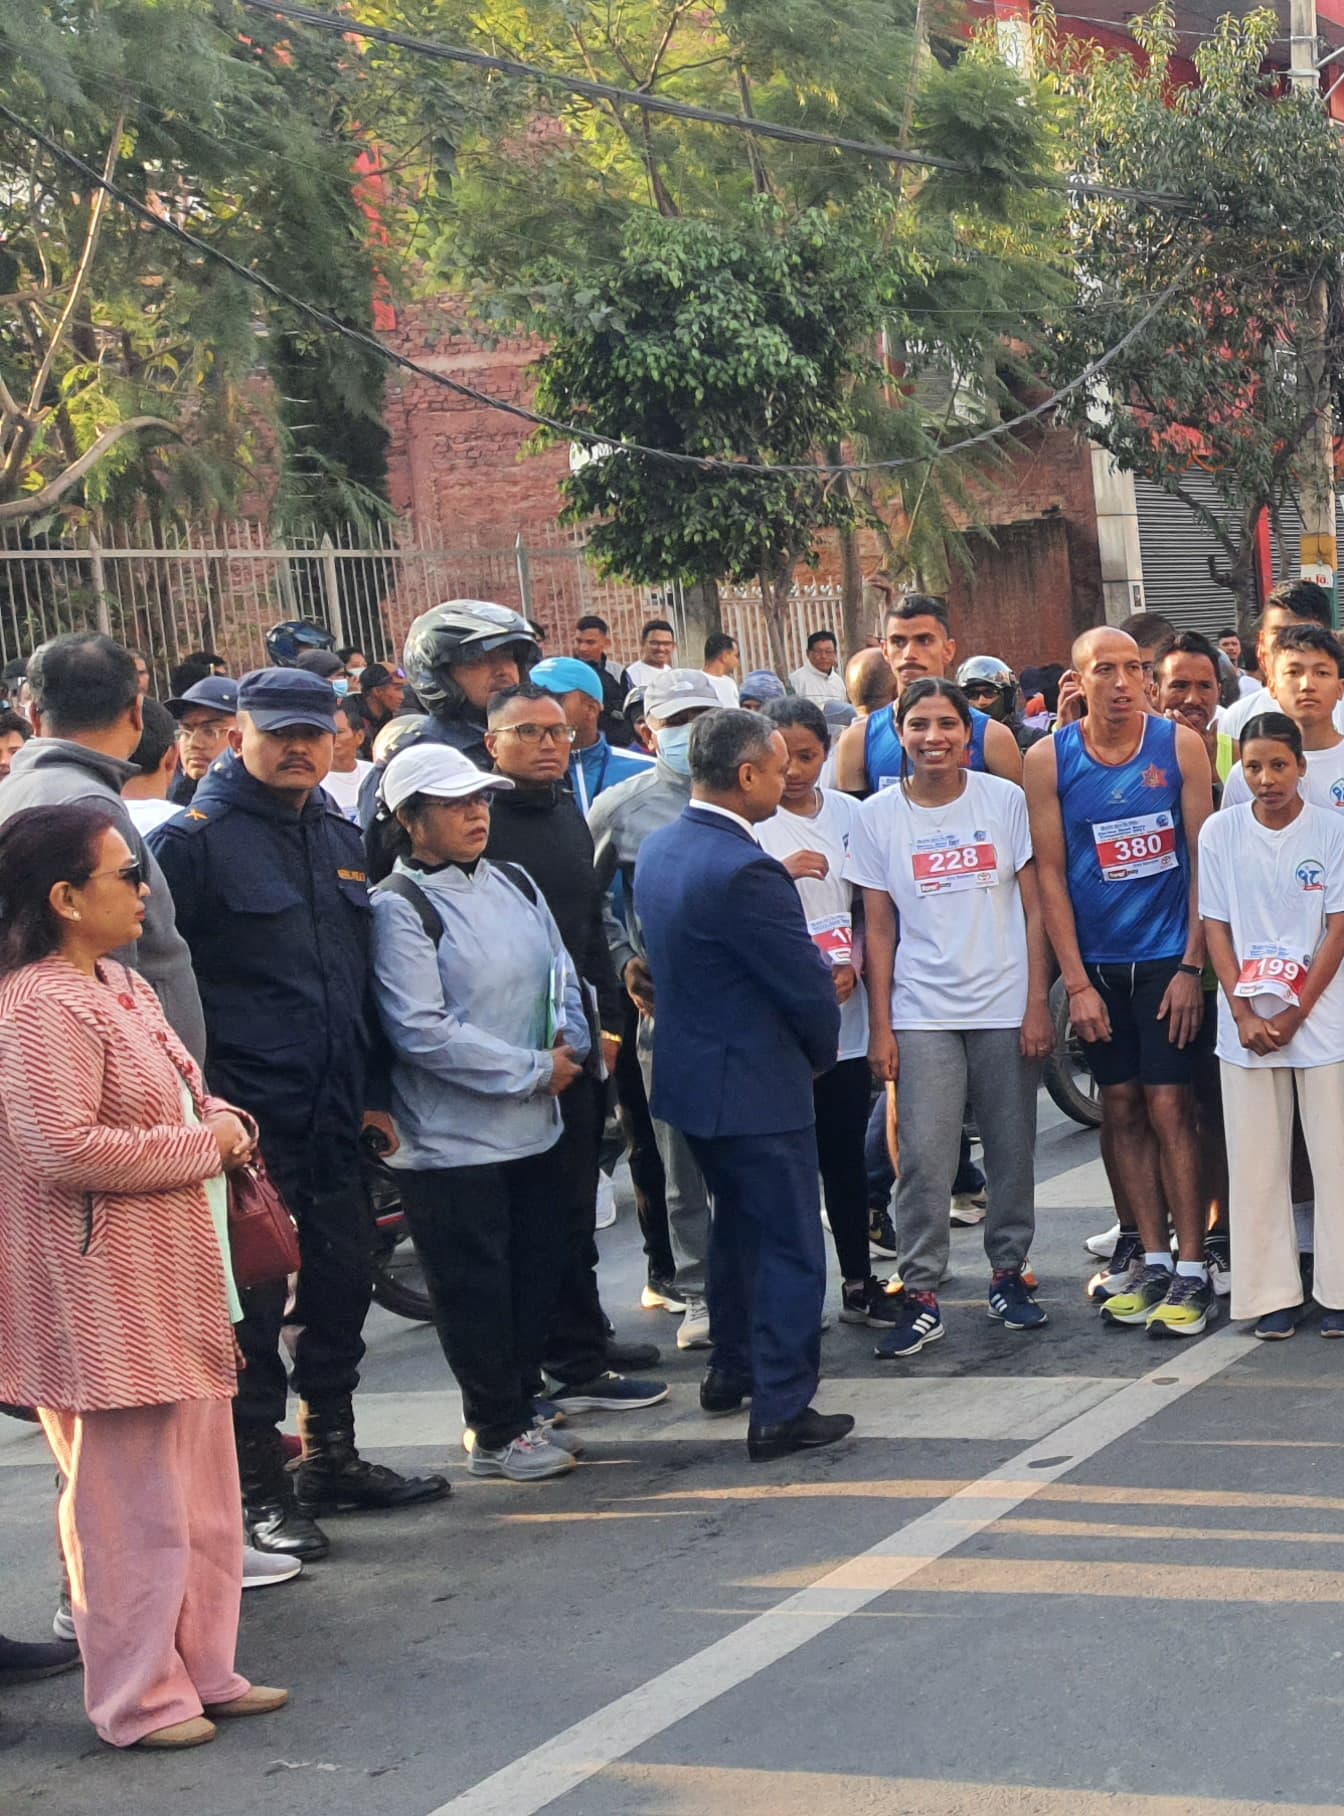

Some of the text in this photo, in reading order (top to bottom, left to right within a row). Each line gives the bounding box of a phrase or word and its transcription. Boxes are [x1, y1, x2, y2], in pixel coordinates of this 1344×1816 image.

[928, 847, 978, 873] 228
[1114, 834, 1162, 861] 380
[1256, 959, 1299, 980] 199
